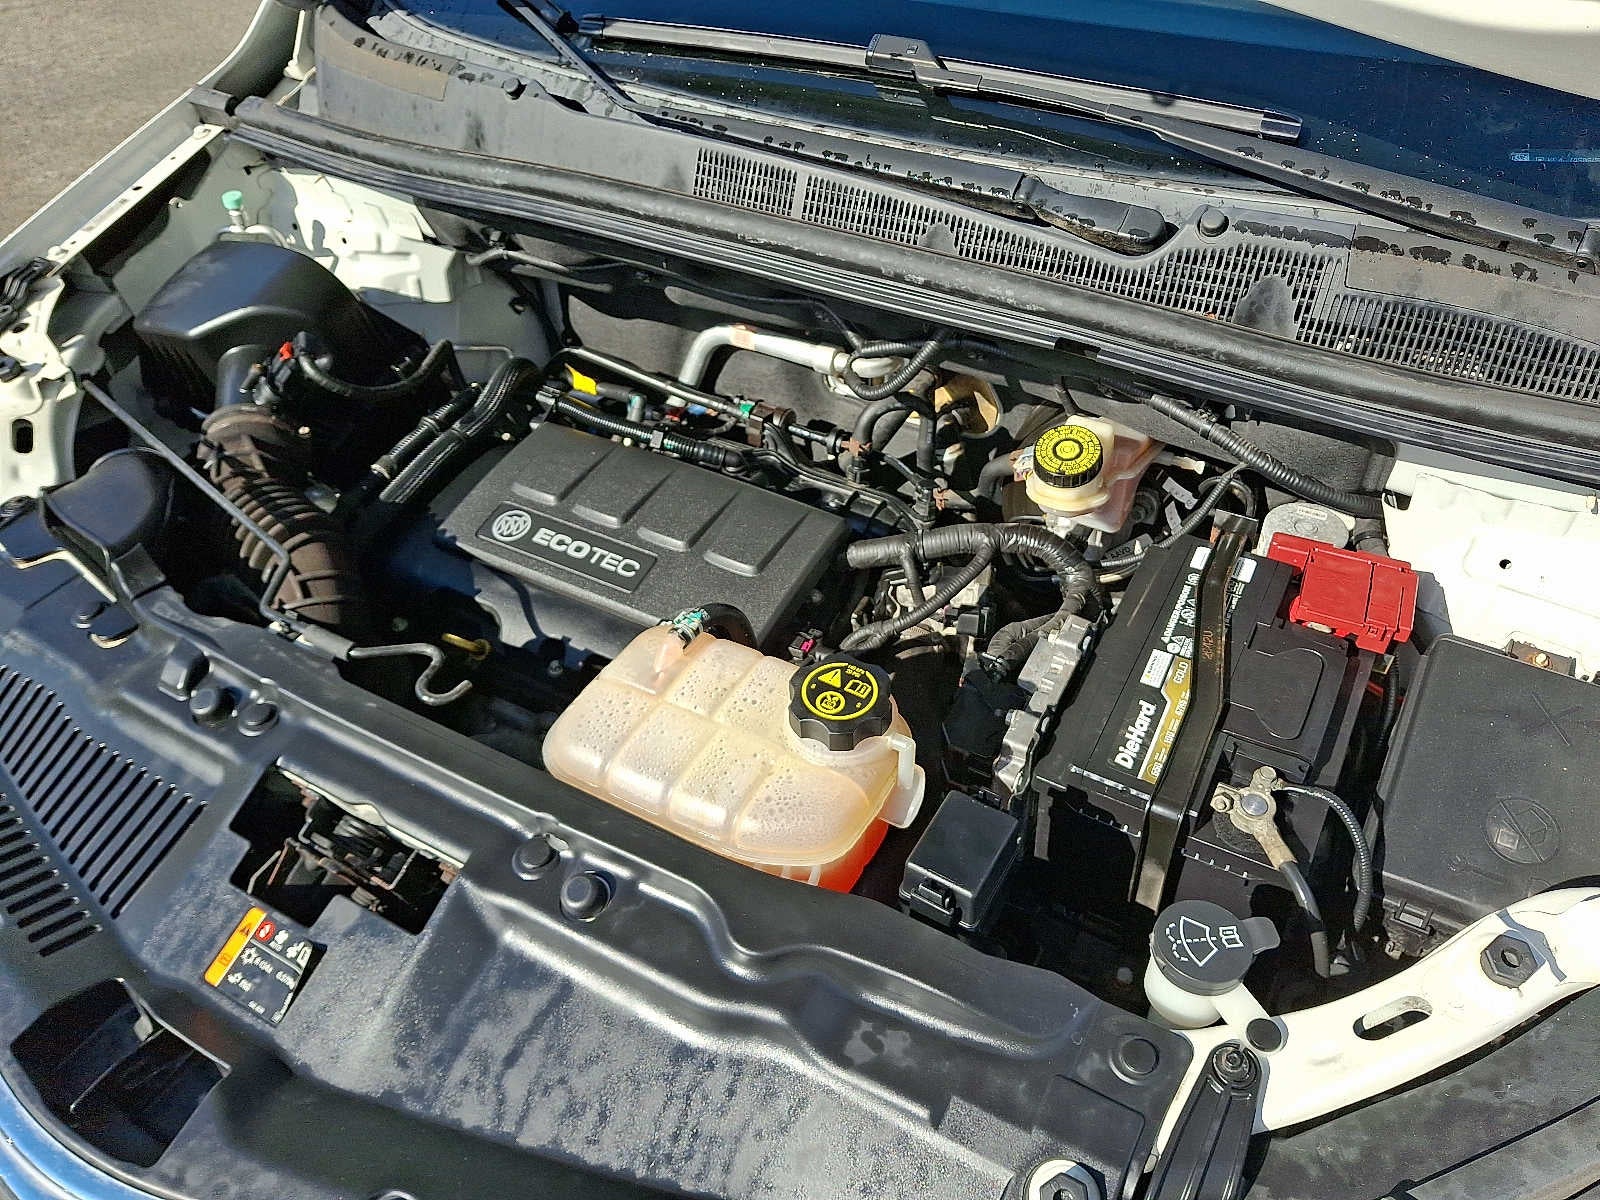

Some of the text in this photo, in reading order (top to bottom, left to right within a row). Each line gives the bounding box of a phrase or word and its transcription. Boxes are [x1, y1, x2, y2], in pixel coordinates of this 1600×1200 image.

[532, 527, 640, 577] ECOTEC
[1174, 661, 1189, 684] GOLD
[1114, 700, 1157, 770] DieHard
